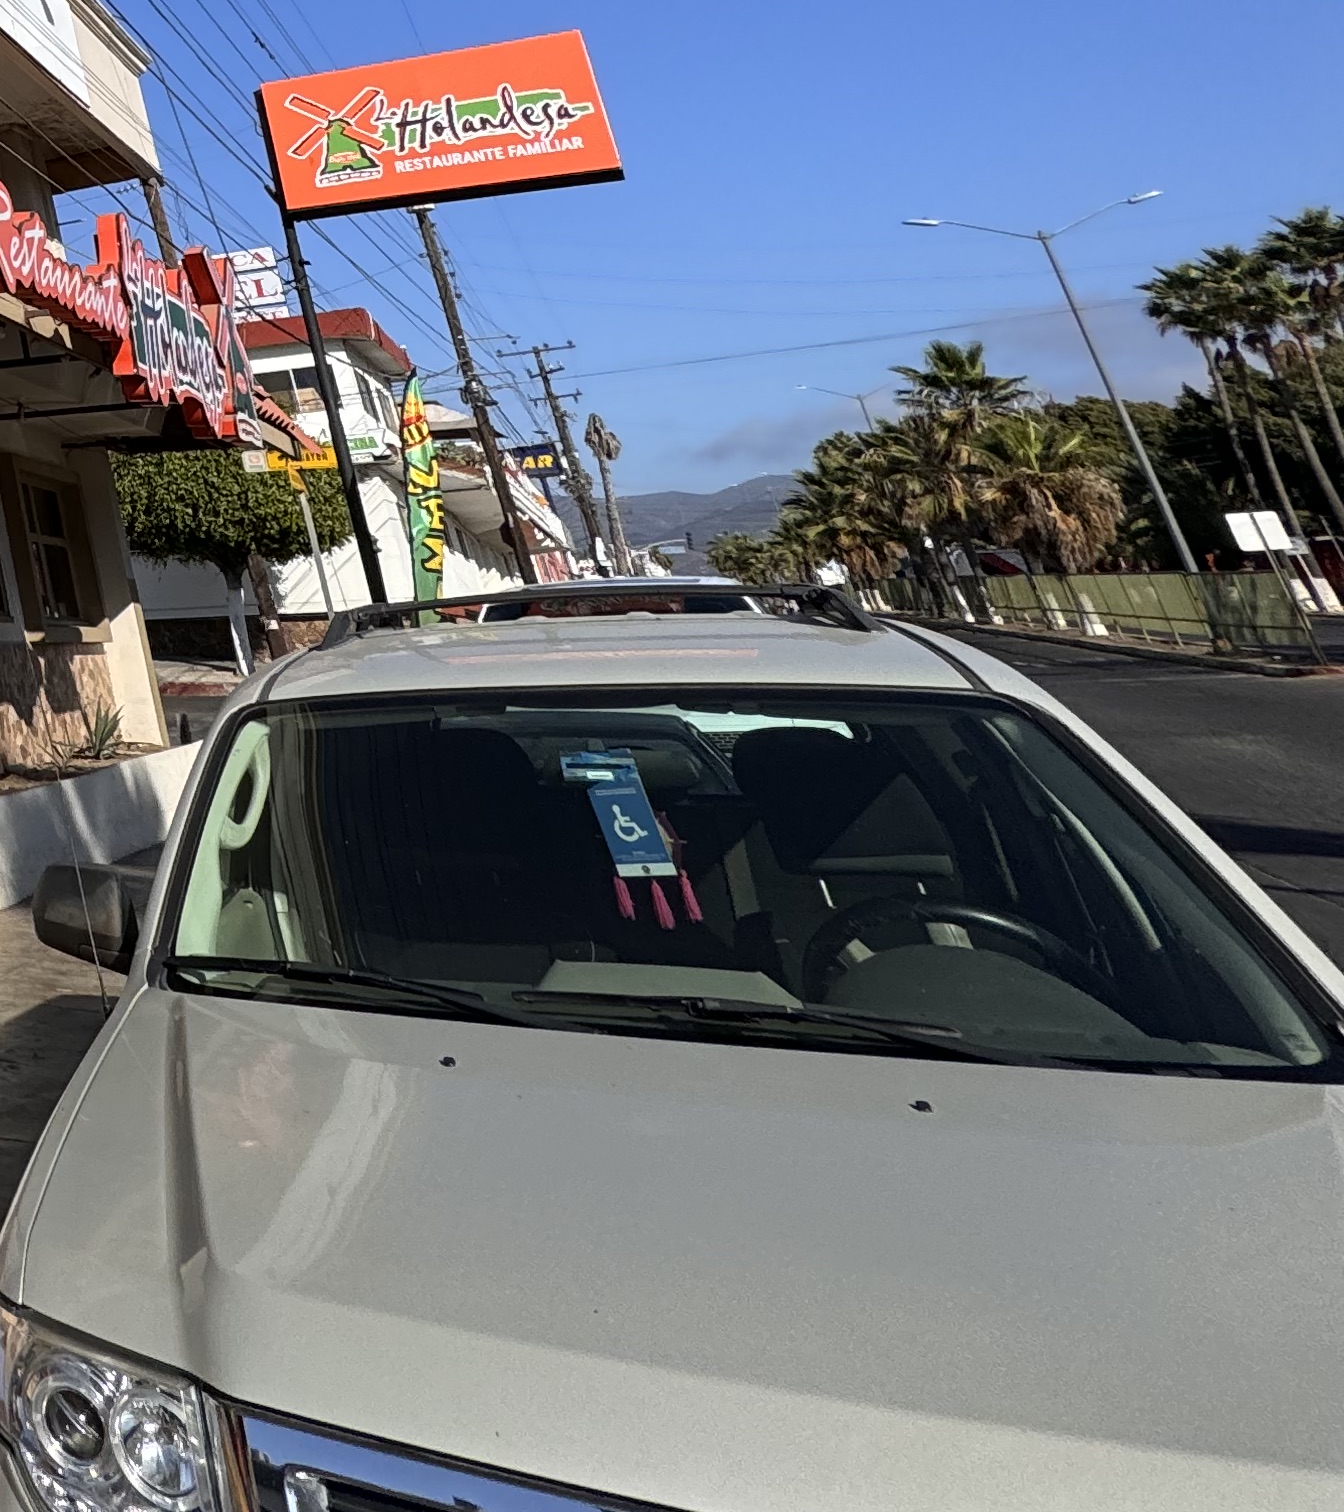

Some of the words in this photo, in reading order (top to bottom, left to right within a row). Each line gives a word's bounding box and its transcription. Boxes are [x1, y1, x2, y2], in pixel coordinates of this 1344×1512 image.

[395, 82, 580, 153] Holandesa
[395, 148, 504, 173] RESTAURANTE
[507, 136, 584, 159] FAMILIAR
